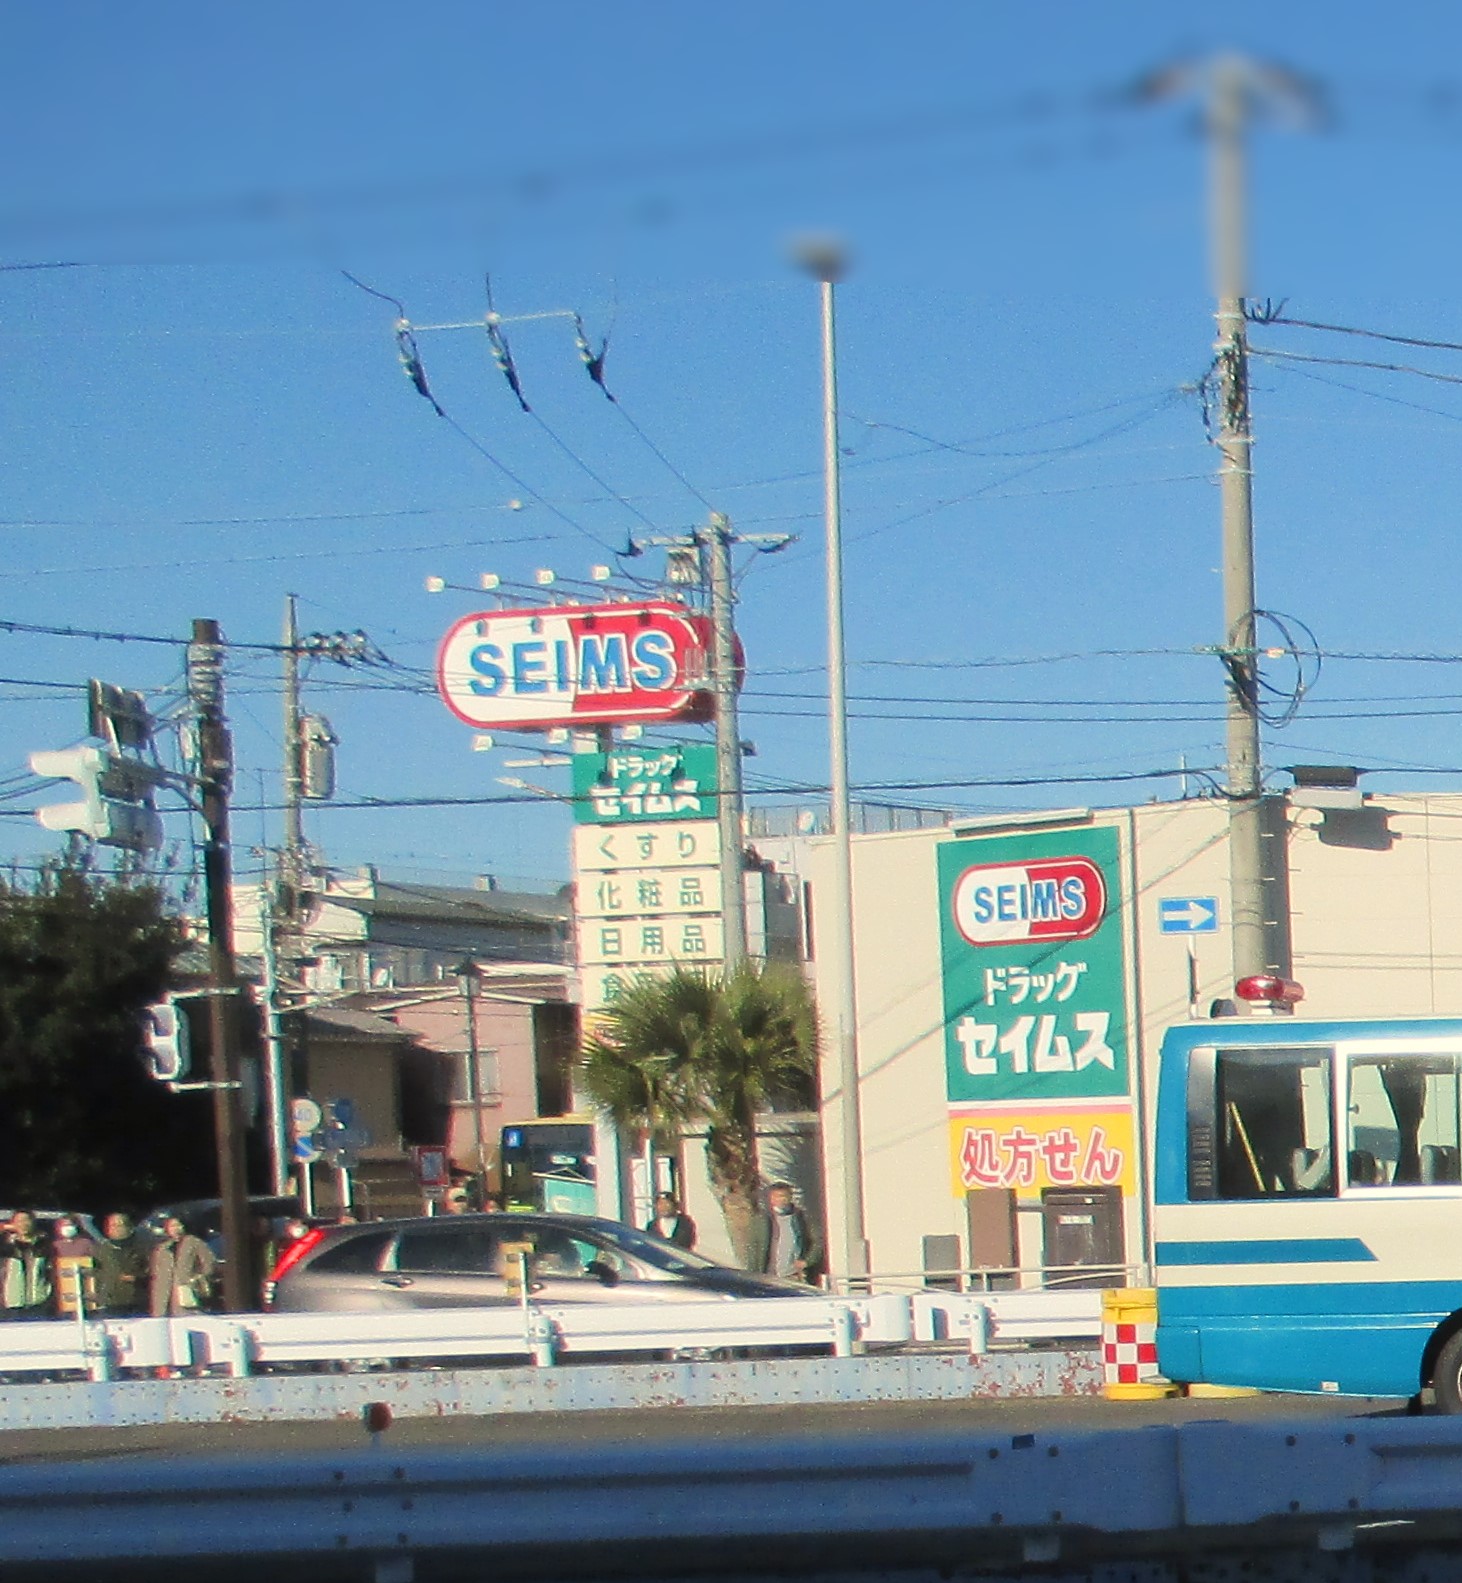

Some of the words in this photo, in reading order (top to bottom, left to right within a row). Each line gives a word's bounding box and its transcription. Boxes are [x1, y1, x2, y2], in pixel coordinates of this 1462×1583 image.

[468, 630, 678, 696] SEIMS
[608, 755, 683, 778] ドラッグ
[590, 780, 701, 815] セイムス
[599, 832, 696, 860] くすり
[597, 877, 703, 910] 化粧品
[974, 876, 1089, 924] SEIMS
[601, 924, 705, 955] 日用品
[984, 961, 1087, 1005] ドラッグ
[957, 1011, 1114, 1075] セイムス
[961, 1126, 1122, 1187] 処方せん
